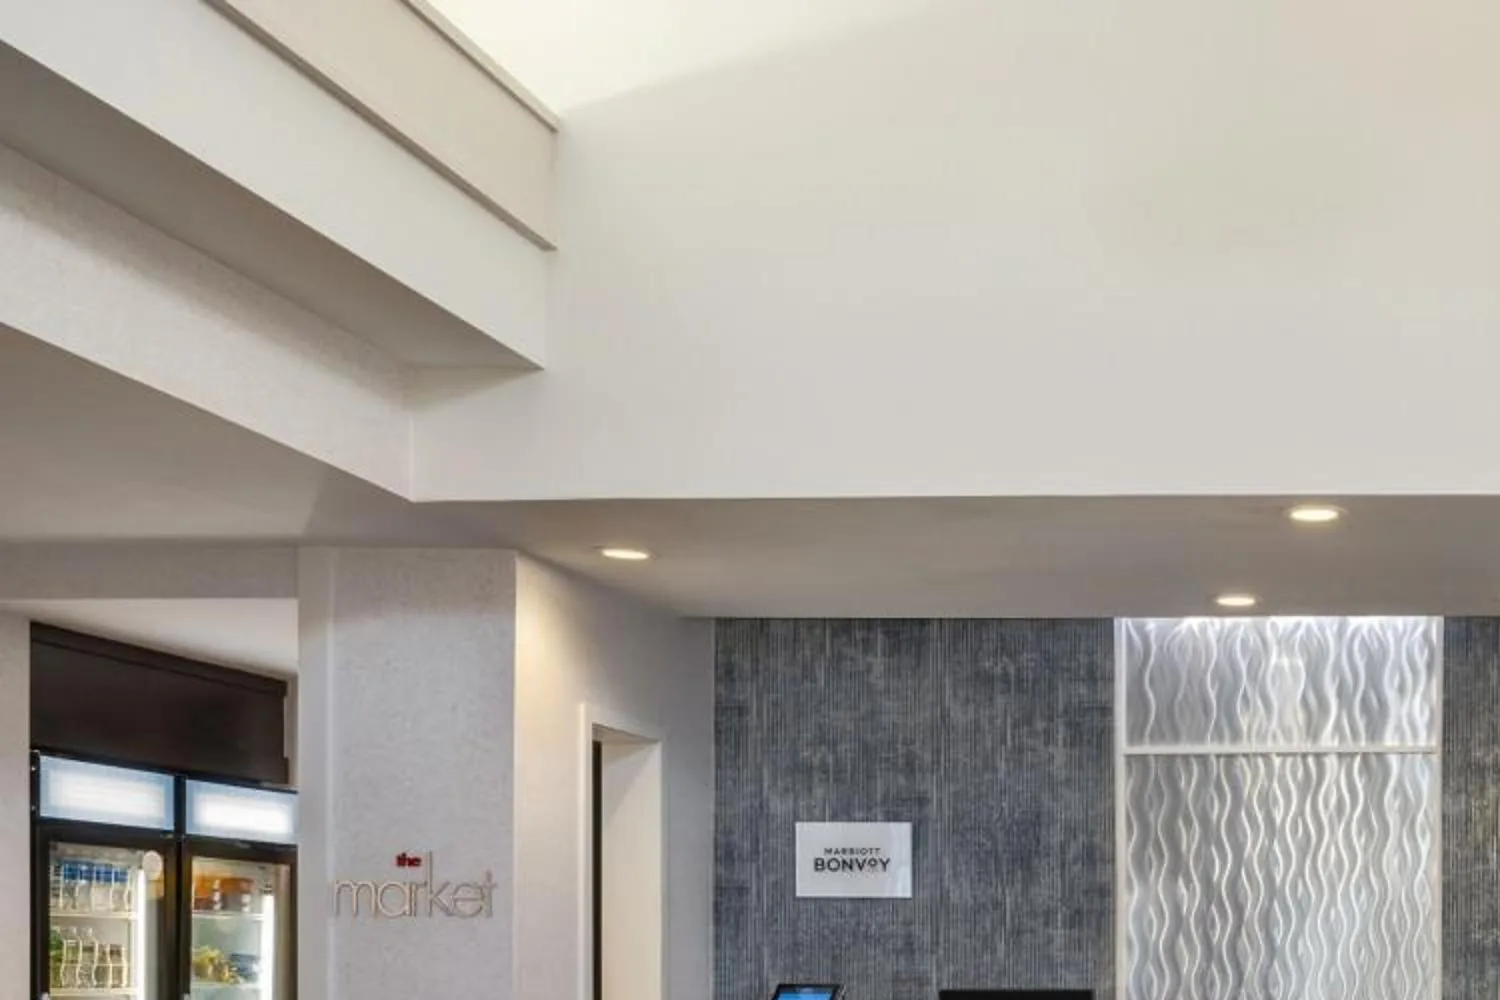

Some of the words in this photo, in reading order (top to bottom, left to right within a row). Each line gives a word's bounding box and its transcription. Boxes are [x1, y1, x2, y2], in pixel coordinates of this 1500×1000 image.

[824, 847, 881, 856] MARRIOTT
[396, 852, 422, 868] the
[814, 857, 891, 872] BONVOY
[335, 851, 497, 918] market
